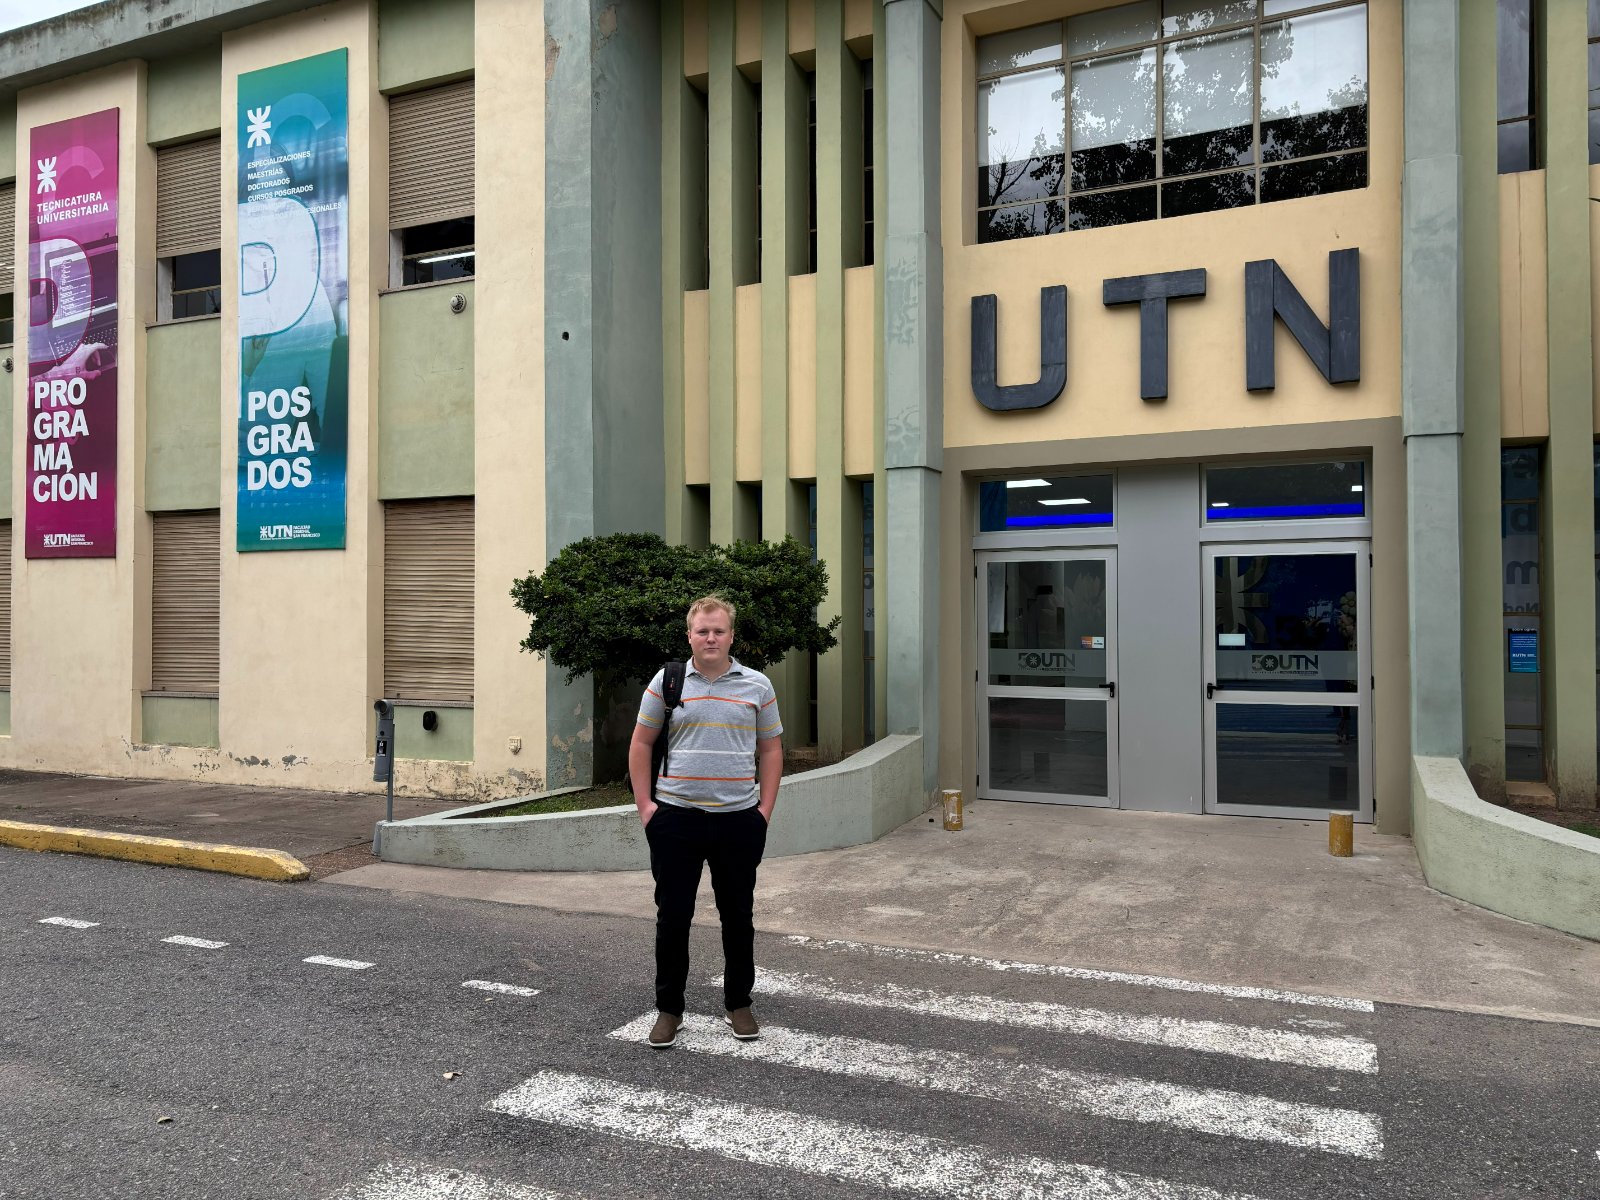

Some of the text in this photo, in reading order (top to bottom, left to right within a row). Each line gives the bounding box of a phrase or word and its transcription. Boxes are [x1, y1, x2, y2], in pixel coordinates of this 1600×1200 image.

[247, 150, 311, 169] ESPECIALIZACIONES
[247, 167, 284, 180] MAESTRÍAS
[247, 177, 291, 191] DOCTORADOS
[36, 191, 103, 213] TECNICATURA
[247, 184, 314, 202] CURSOS POSGRADOS
[36, 202, 109, 225] UNIVERSITARIA
[970, 247, 1361, 412] UTN
[34, 377, 87, 409] PRO
[247, 385, 311, 422] POS
[33, 409, 90, 440] GRA
[246, 421, 315, 456] GRA
[33, 442, 74, 472] MA
[32, 469, 98, 503] CIÓN
[247, 456, 312, 491] DOS
[49, 533, 71, 545] UTN
[267, 524, 293, 538] UTN
